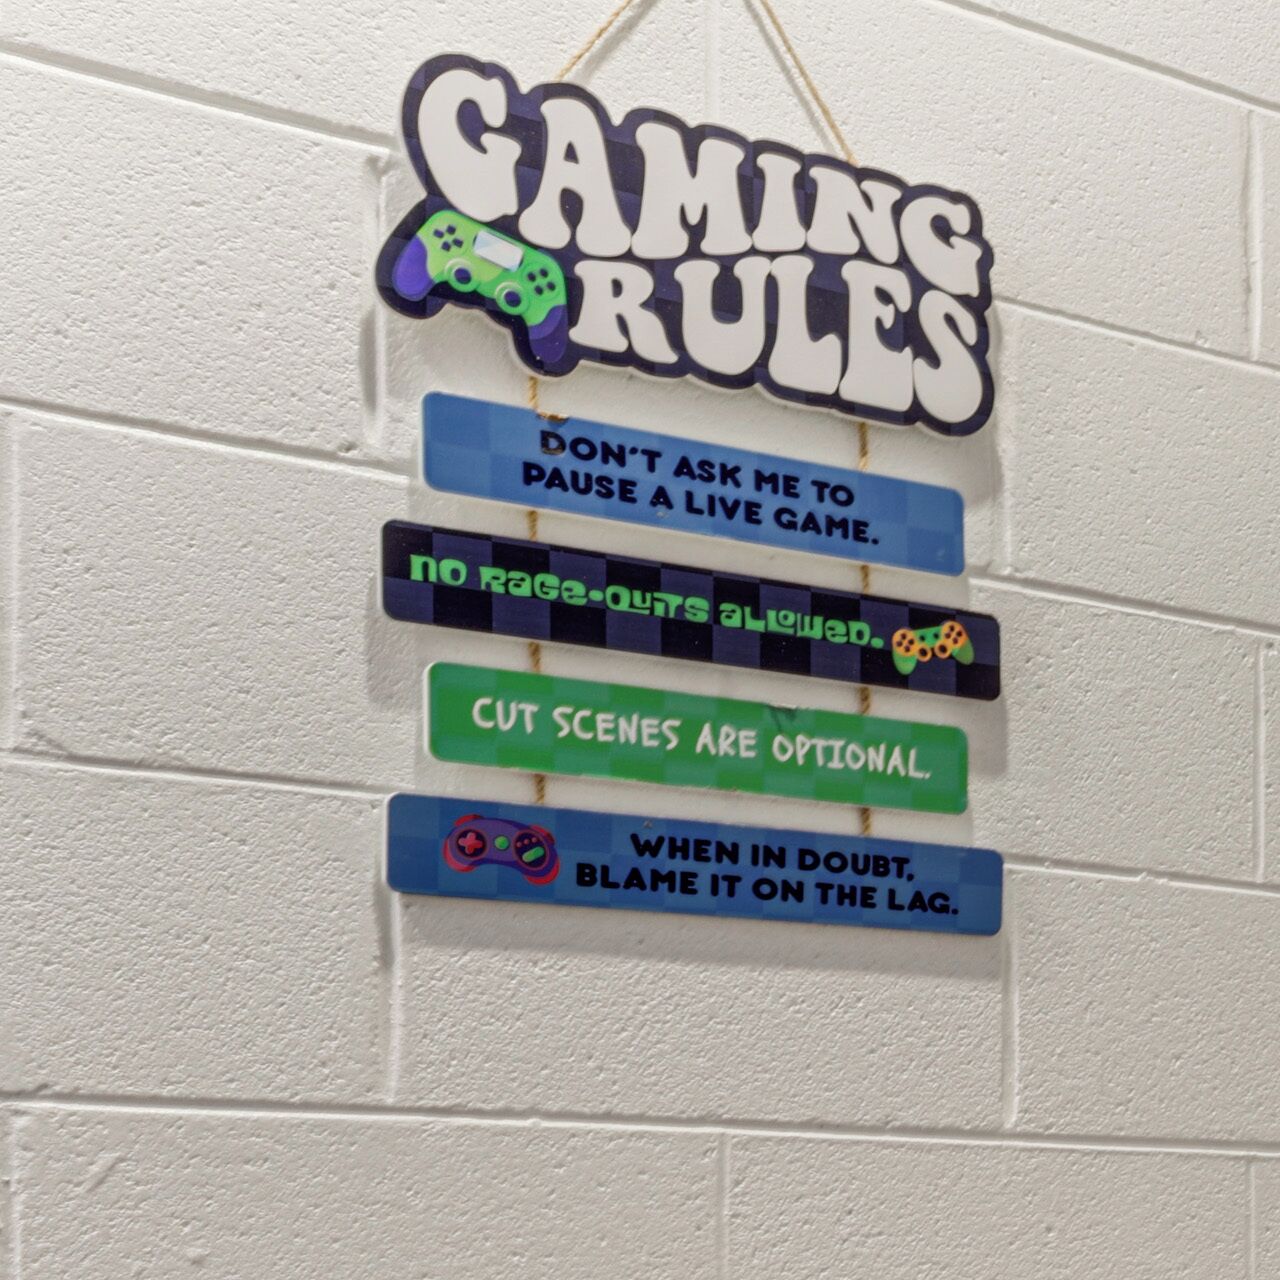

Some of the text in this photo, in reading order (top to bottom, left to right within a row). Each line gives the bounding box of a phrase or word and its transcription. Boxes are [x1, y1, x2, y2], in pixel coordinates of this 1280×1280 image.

[418, 67, 982, 298] GAMING
[568, 254, 983, 425] RULES
[522, 461, 880, 545] PAUSE A LIVE GAME.
[540, 429, 855, 508] DON'T ASK ME TO
[471, 697, 932, 780] CUT SCENES ARE OPTIONAL.
[575, 862, 960, 916] BLAME IT ON THE LAG.
[629, 833, 915, 883] WHEN IN DOUBT,
